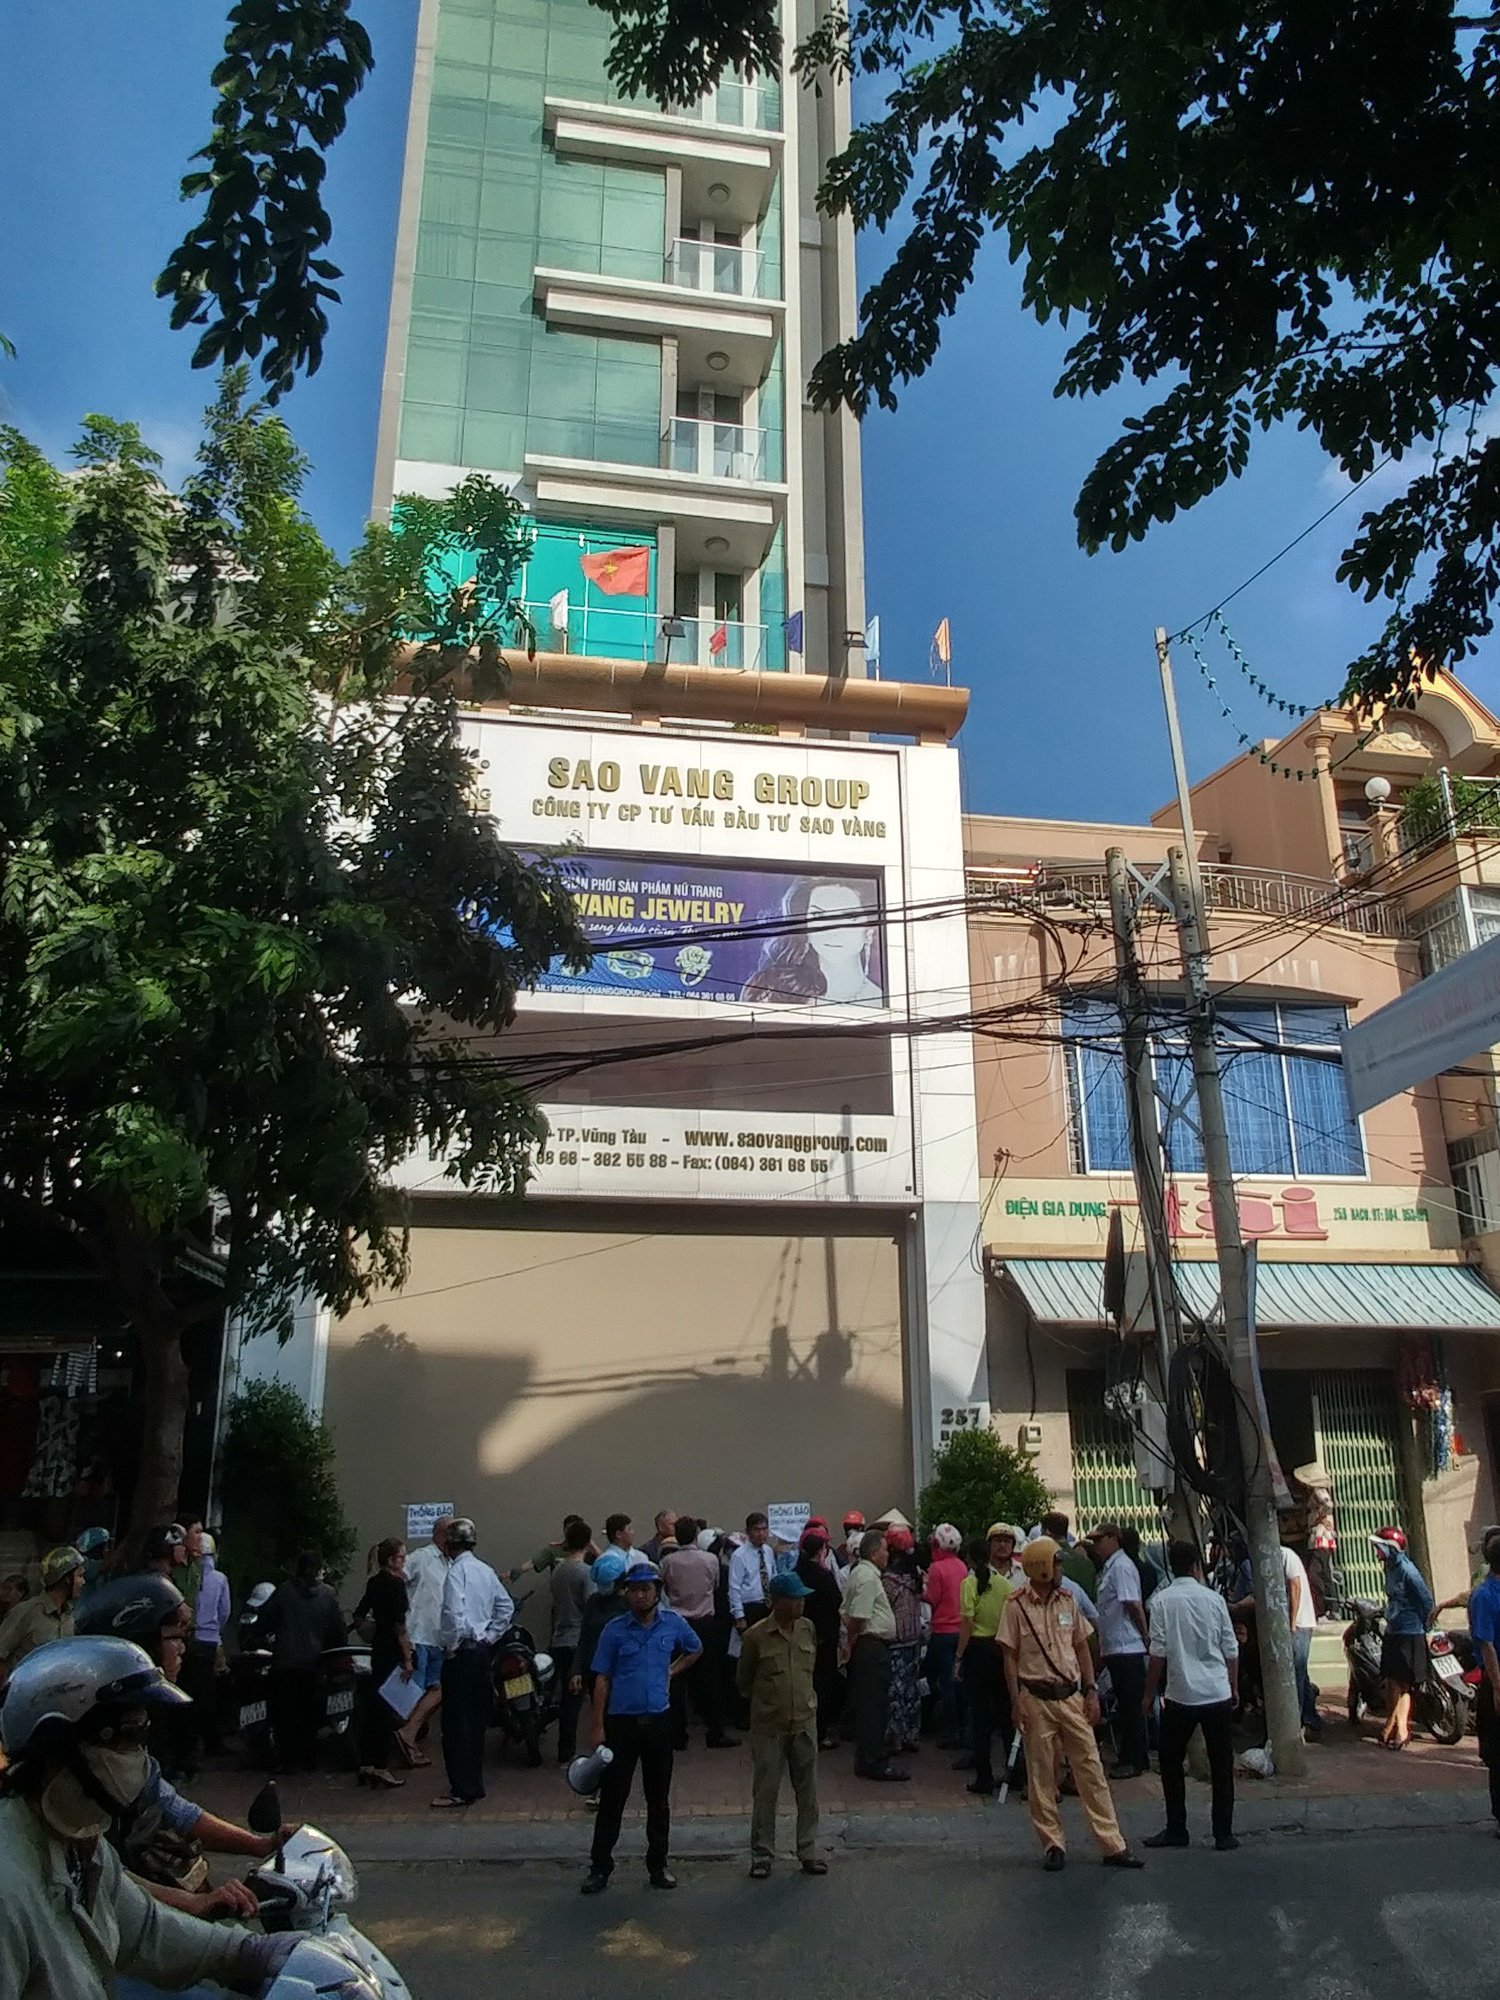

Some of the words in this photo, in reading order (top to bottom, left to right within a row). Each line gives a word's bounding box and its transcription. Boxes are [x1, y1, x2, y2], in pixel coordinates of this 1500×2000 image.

[547, 757, 621, 792] SAO
[639, 764, 734, 800] VANG
[754, 772, 870, 809] GROUP
[532, 796, 581, 818] CÔNG
[588, 804, 610, 819] TY
[618, 803, 642, 822] CP
[650, 806, 674, 824] TƯ
[682, 802, 715, 828] VẤN
[767, 814, 791, 832] TƯ
[800, 815, 834, 836] SAO
[842, 815, 886, 838] VÀNG
[591, 876, 615, 892] PHỐI
[690, 885, 723, 899] TRANG
[574, 893, 635, 919] VANG
[640, 898, 745, 925] JEWELRY
[623, 1127, 647, 1144] Tàu
[1005, 1196, 1038, 1219] ĐIỆN
[1042, 1200, 1066, 1217] GIA
[1069, 1201, 1107, 1222] DỤNG
[941, 1408, 980, 1425] 257
